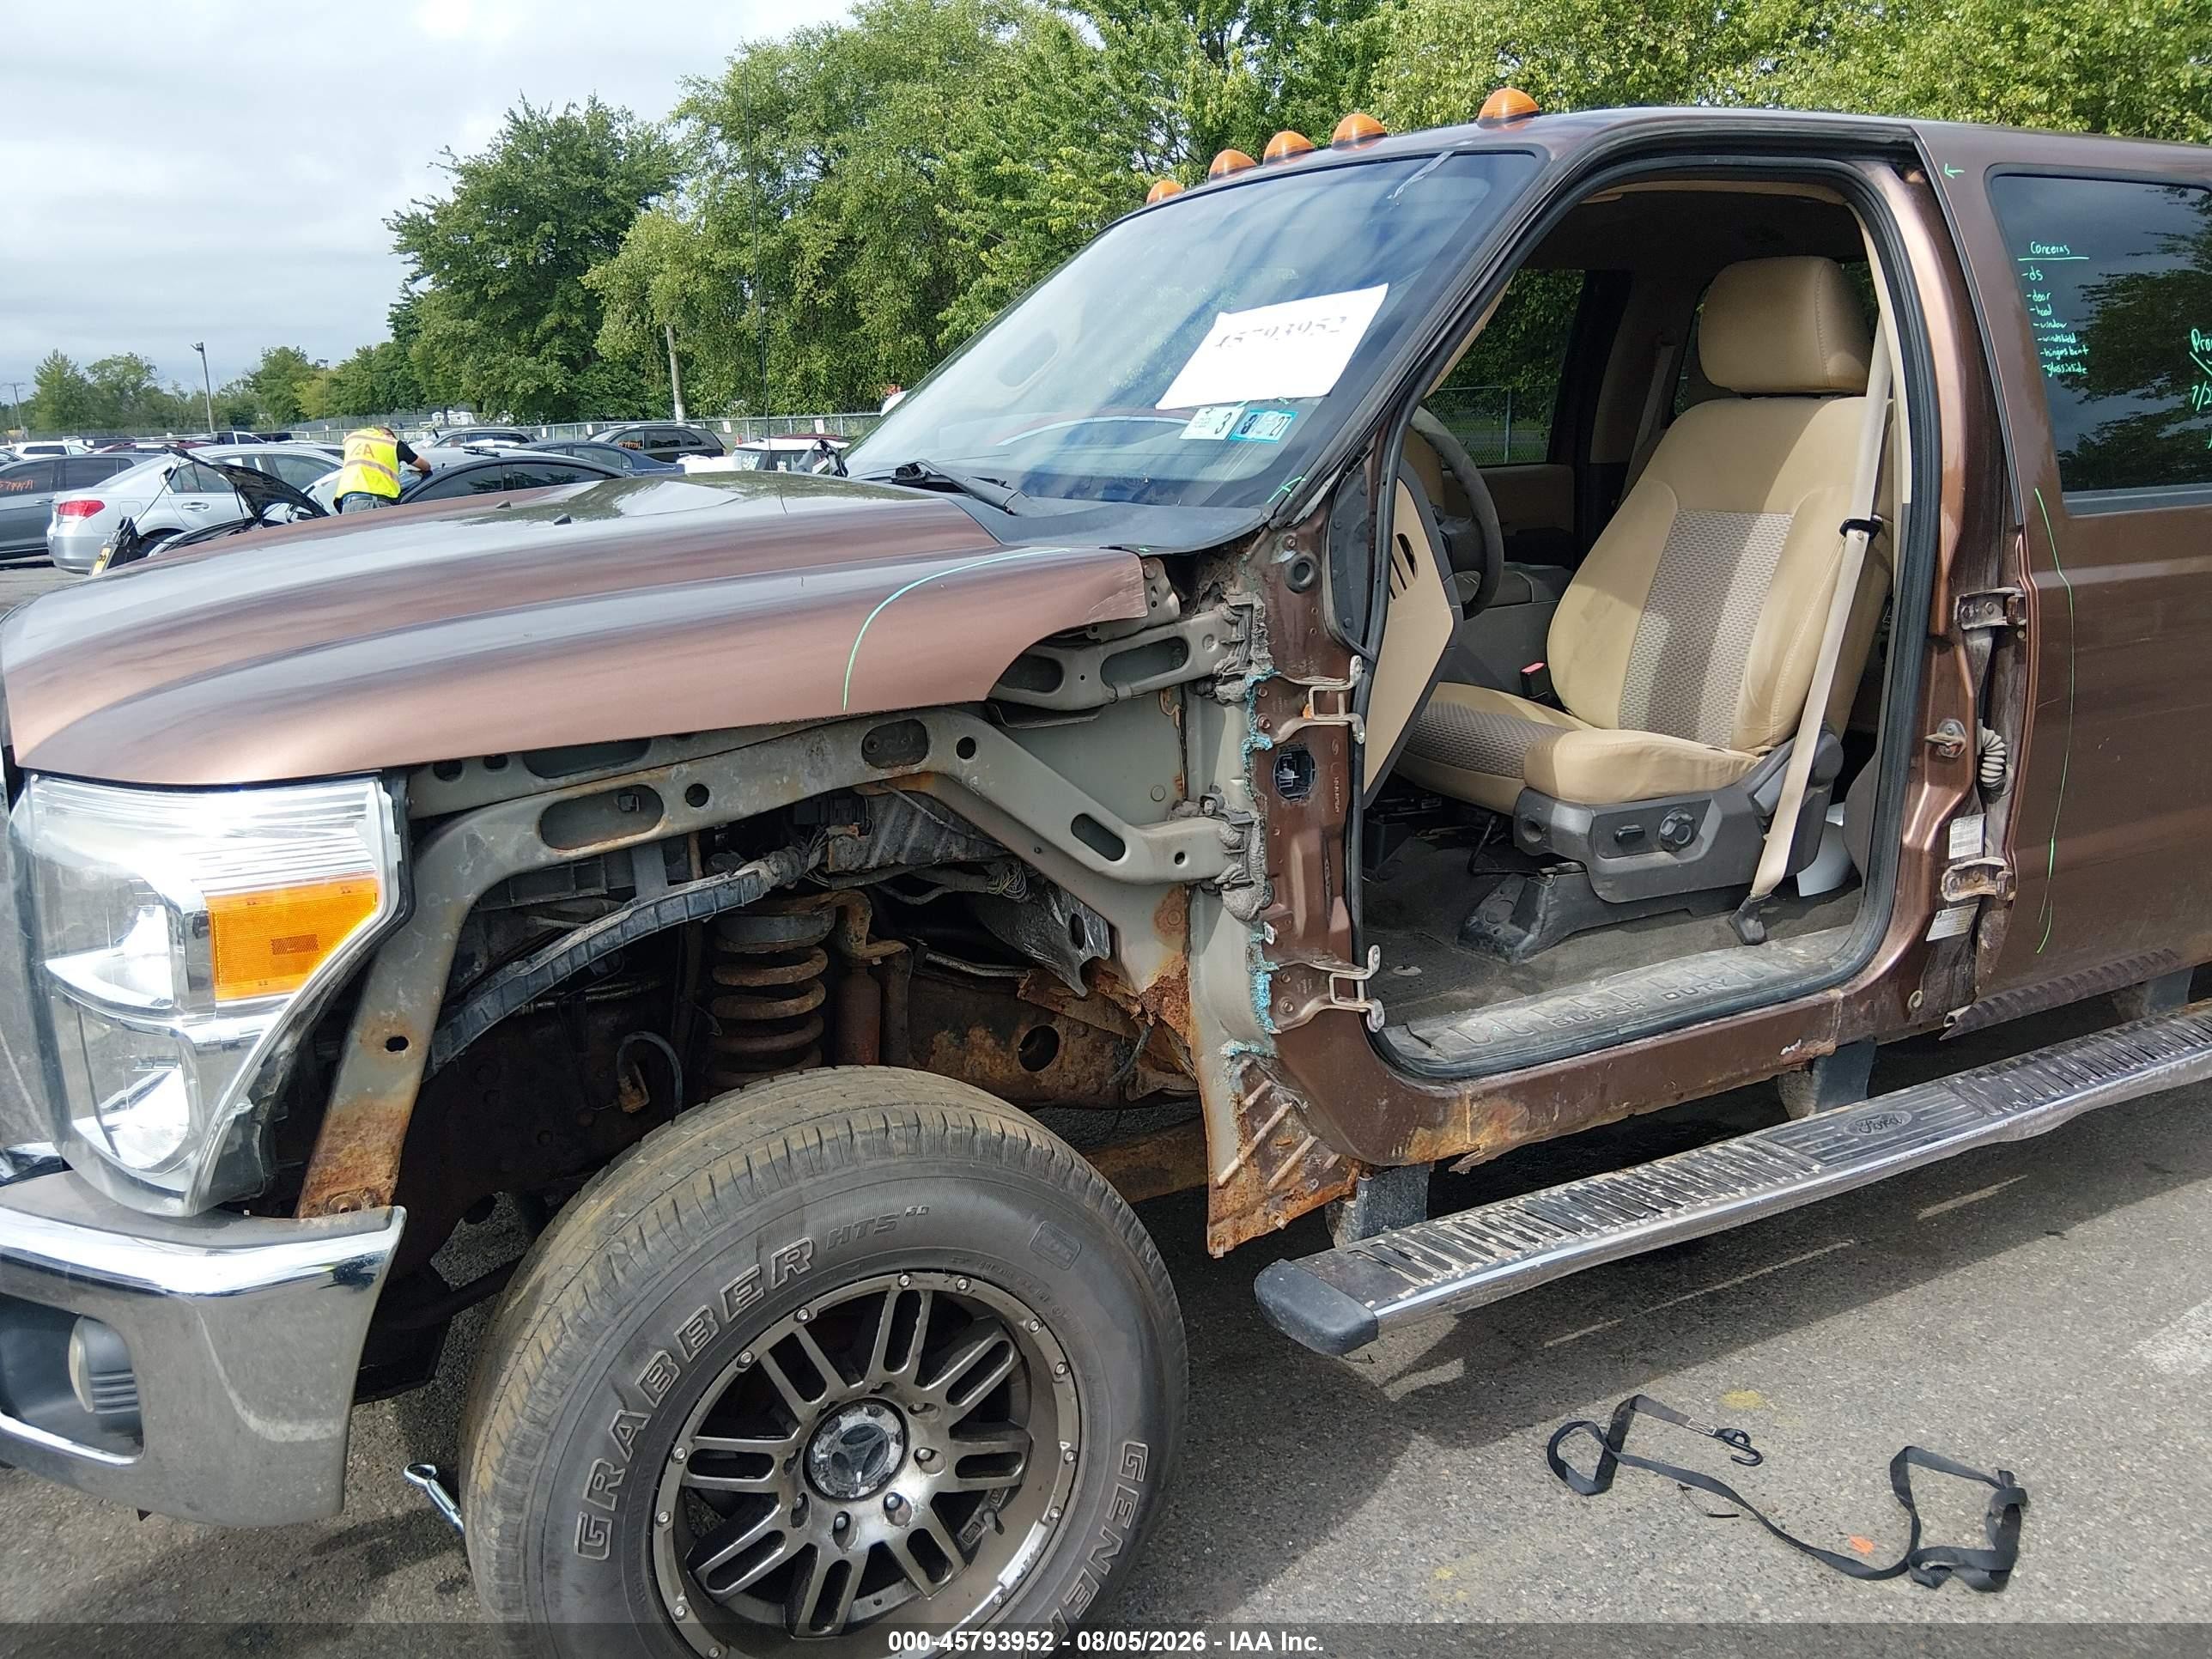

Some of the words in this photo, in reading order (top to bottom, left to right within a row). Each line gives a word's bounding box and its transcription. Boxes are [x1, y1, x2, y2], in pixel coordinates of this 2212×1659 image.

[1549, 1000, 1647, 1028] SUPER
[1660, 978, 1730, 1001] DUTY
[1855, 1114, 1904, 1134] Ford
[574, 1237, 814, 1560] GRABBER
